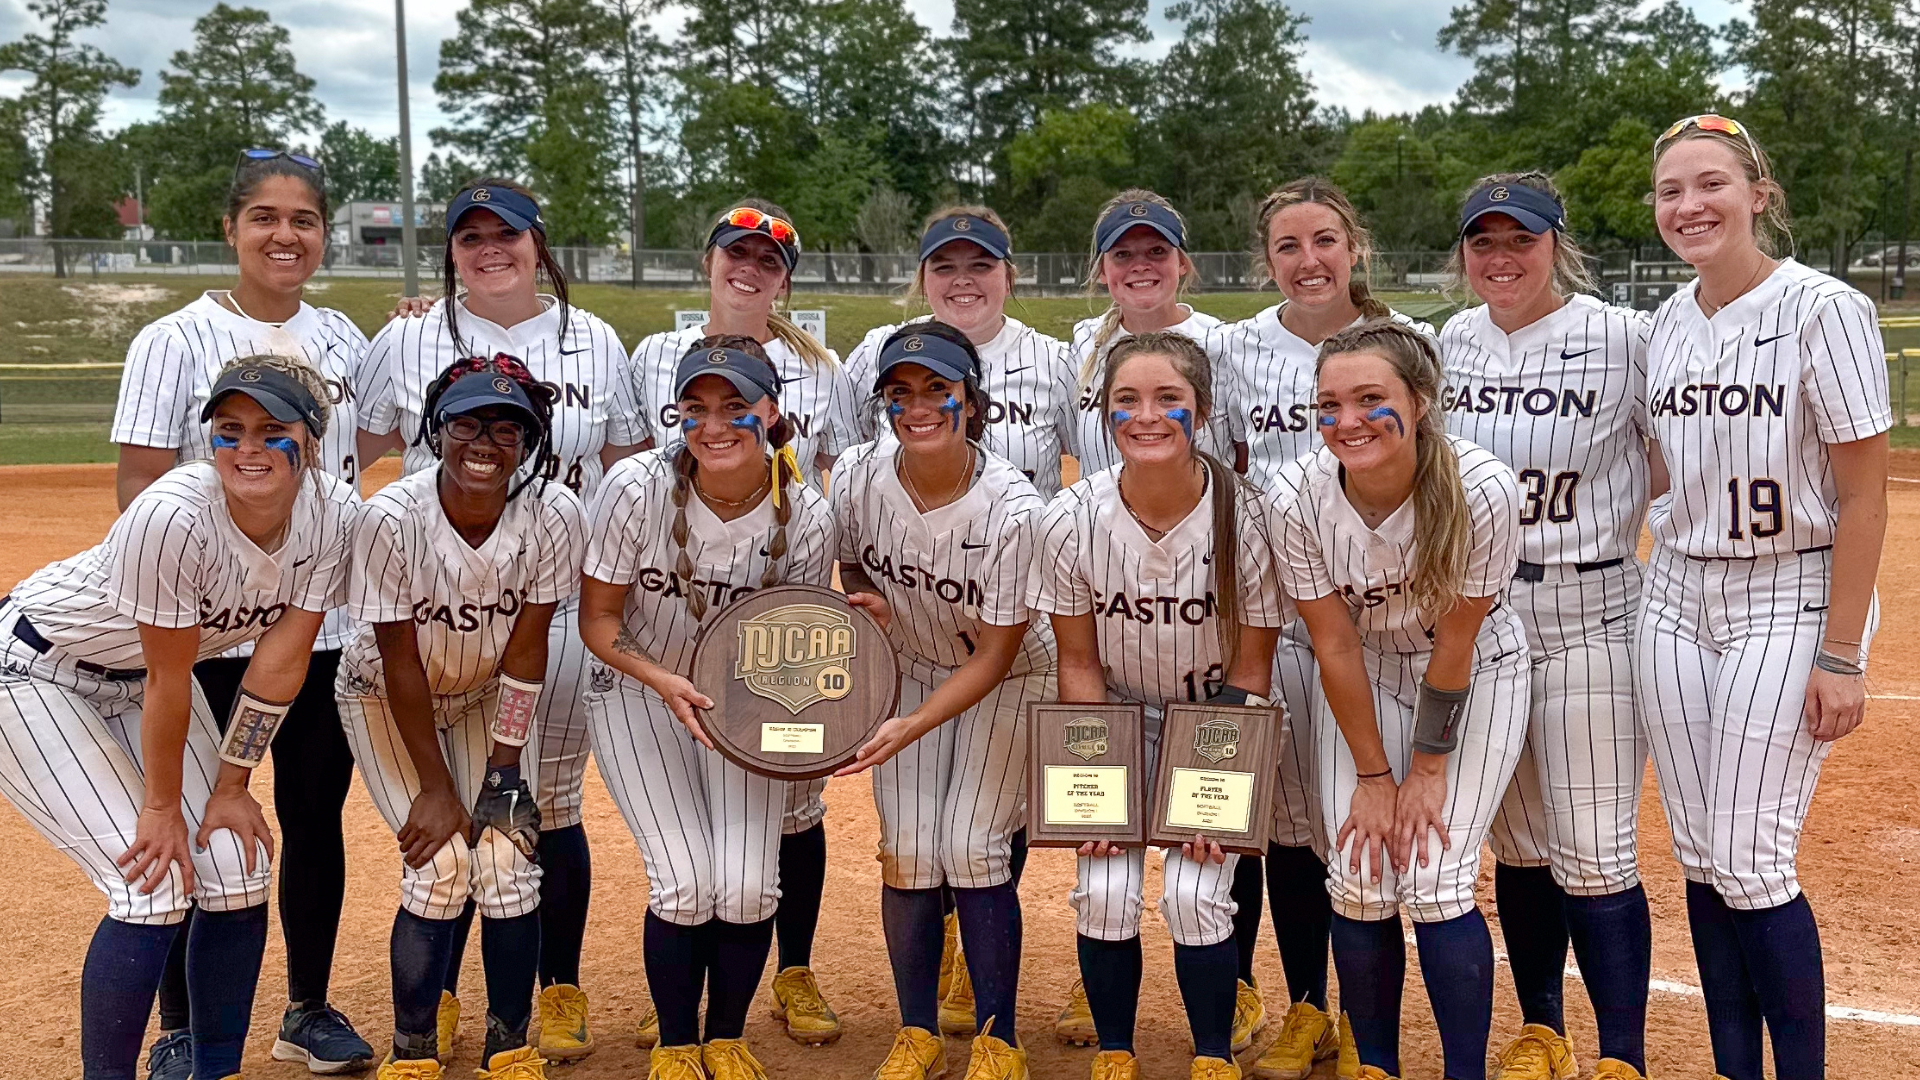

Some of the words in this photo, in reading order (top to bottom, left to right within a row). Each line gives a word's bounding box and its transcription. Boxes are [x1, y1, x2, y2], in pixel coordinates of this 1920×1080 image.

[1440, 384, 1597, 418] GASTON
[1650, 383, 1786, 418] GASTON
[1519, 468, 1580, 526] 30
[1727, 476, 1785, 542] 19
[741, 625, 851, 672] NJCAA
[760, 675, 812, 687] REGION
[822, 673, 845, 690] 10
[1196, 727, 1238, 746] NJCAA
[1225, 747, 1234, 755] 10
